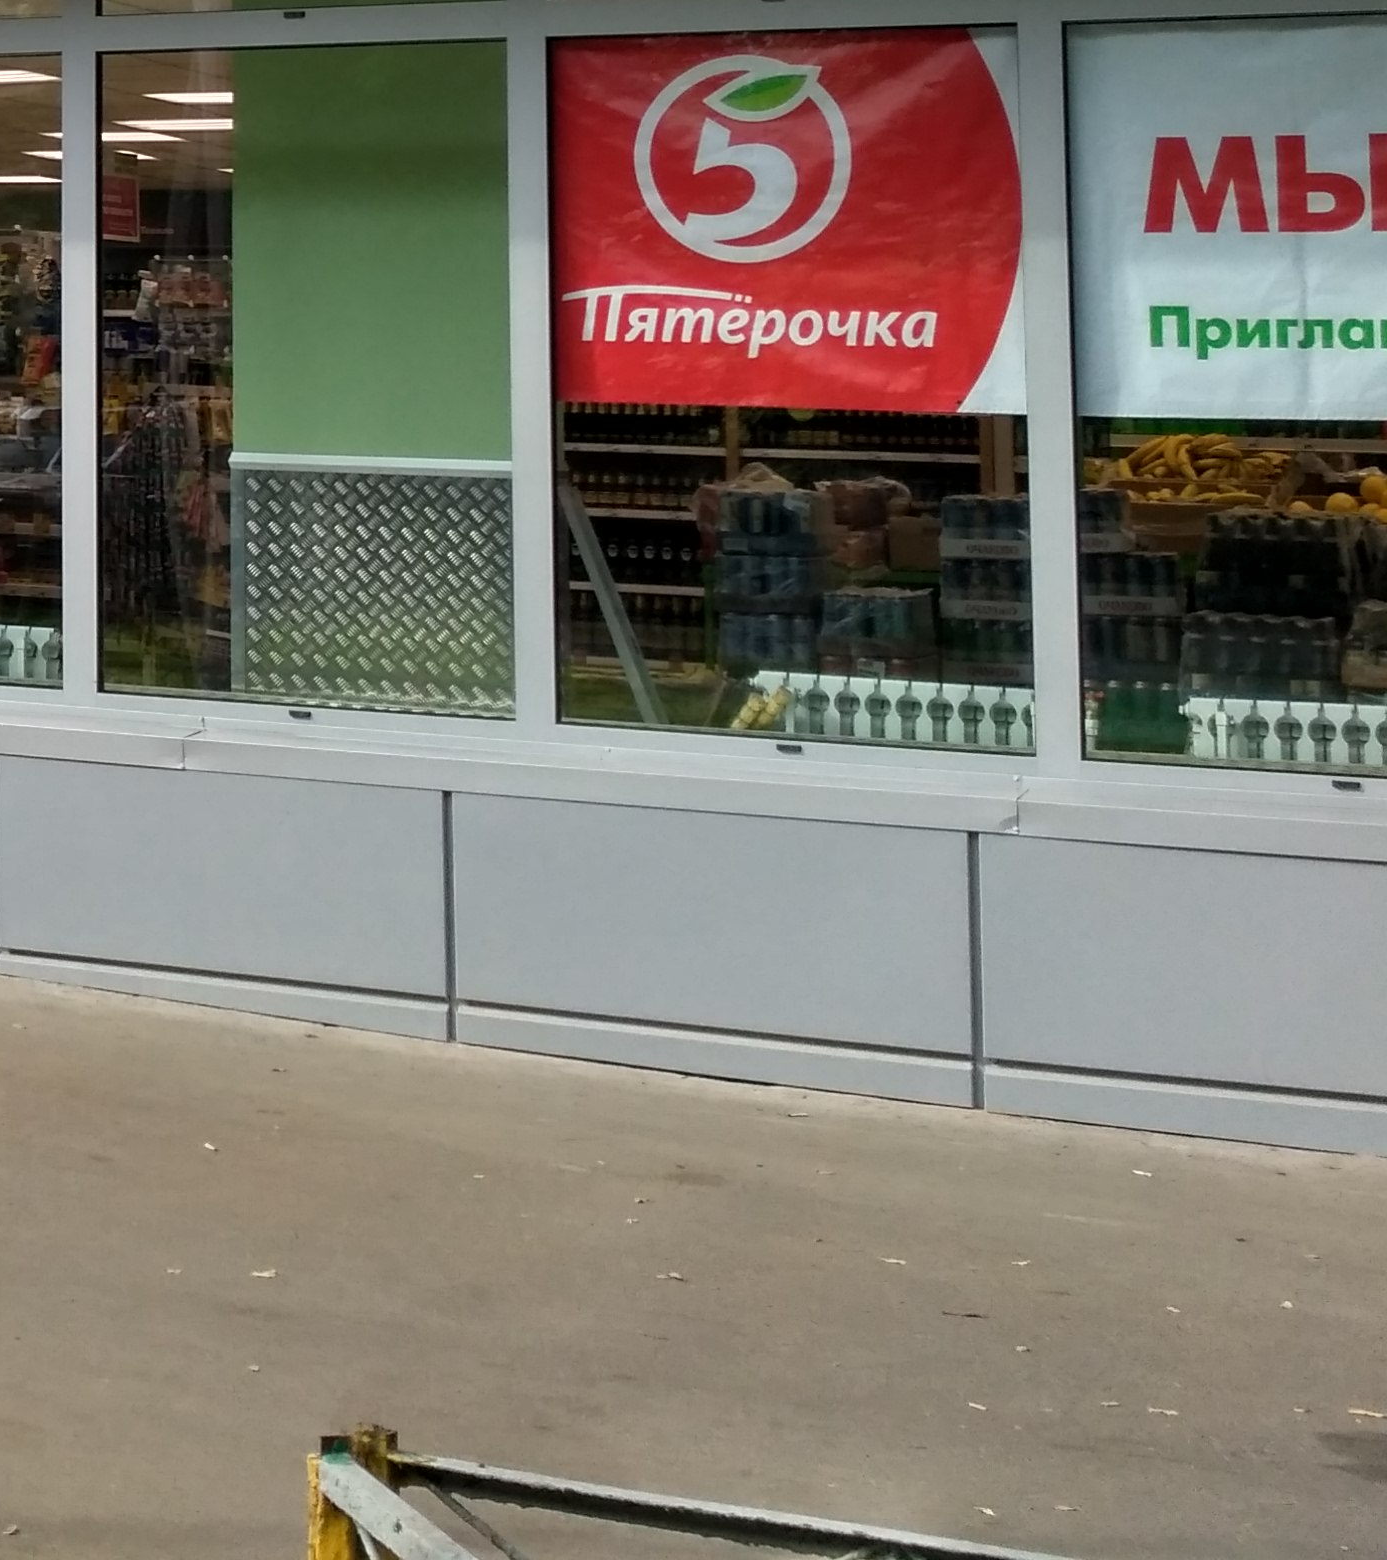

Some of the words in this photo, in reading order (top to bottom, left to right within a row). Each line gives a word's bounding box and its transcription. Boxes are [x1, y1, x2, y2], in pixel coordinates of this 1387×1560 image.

[1143, 133, 1387, 233] МЫ
[562, 285, 938, 358] Пятёрочка
[1149, 305, 1387, 360] Пригла
